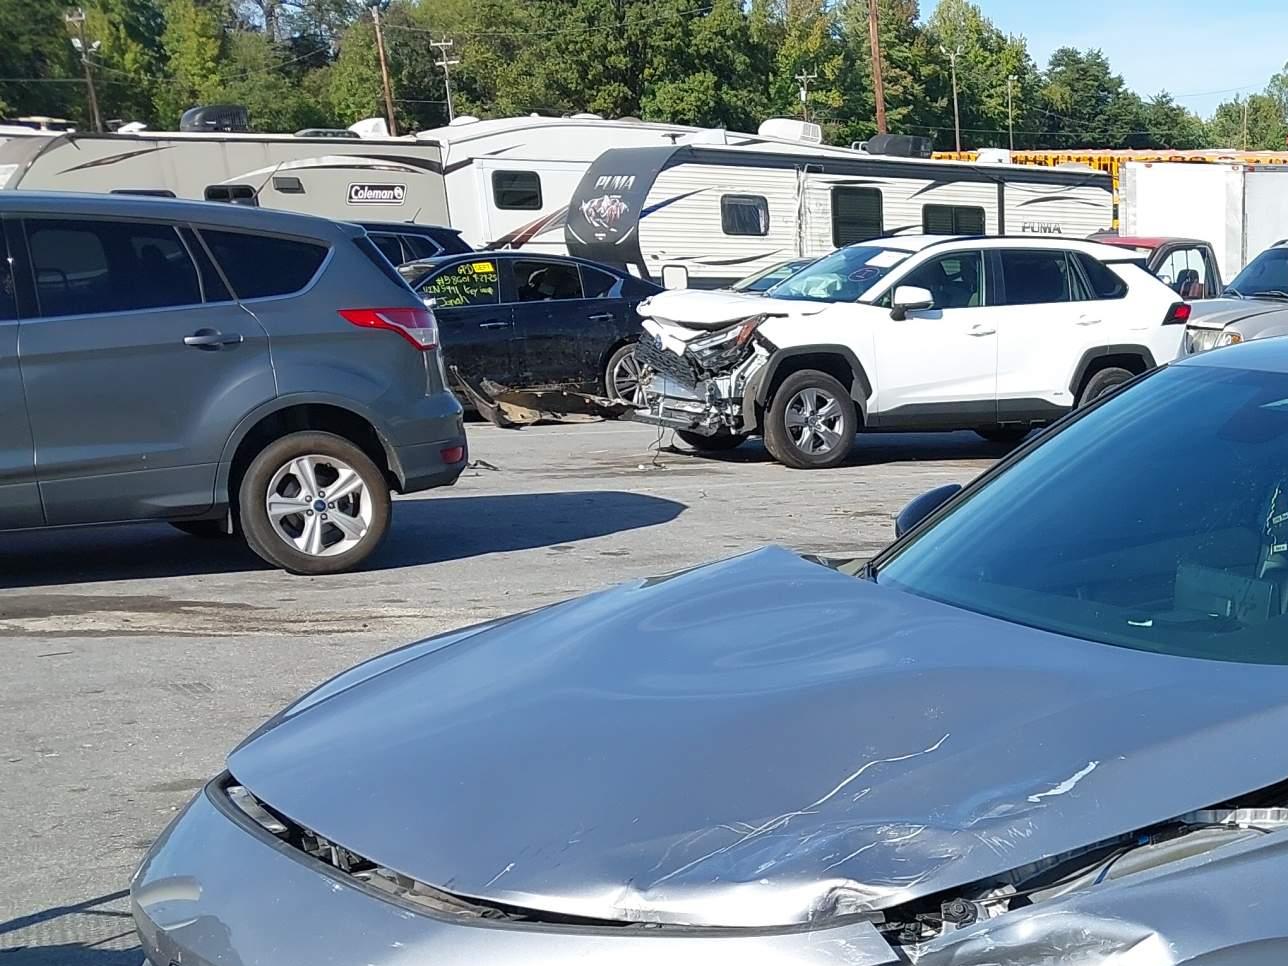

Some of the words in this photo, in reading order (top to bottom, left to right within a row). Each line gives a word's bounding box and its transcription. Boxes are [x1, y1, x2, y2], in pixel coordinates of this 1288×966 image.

[593, 175, 636, 190] PUMA
[351, 185, 394, 199] Coleman
[1021, 221, 1063, 234] PUMA
